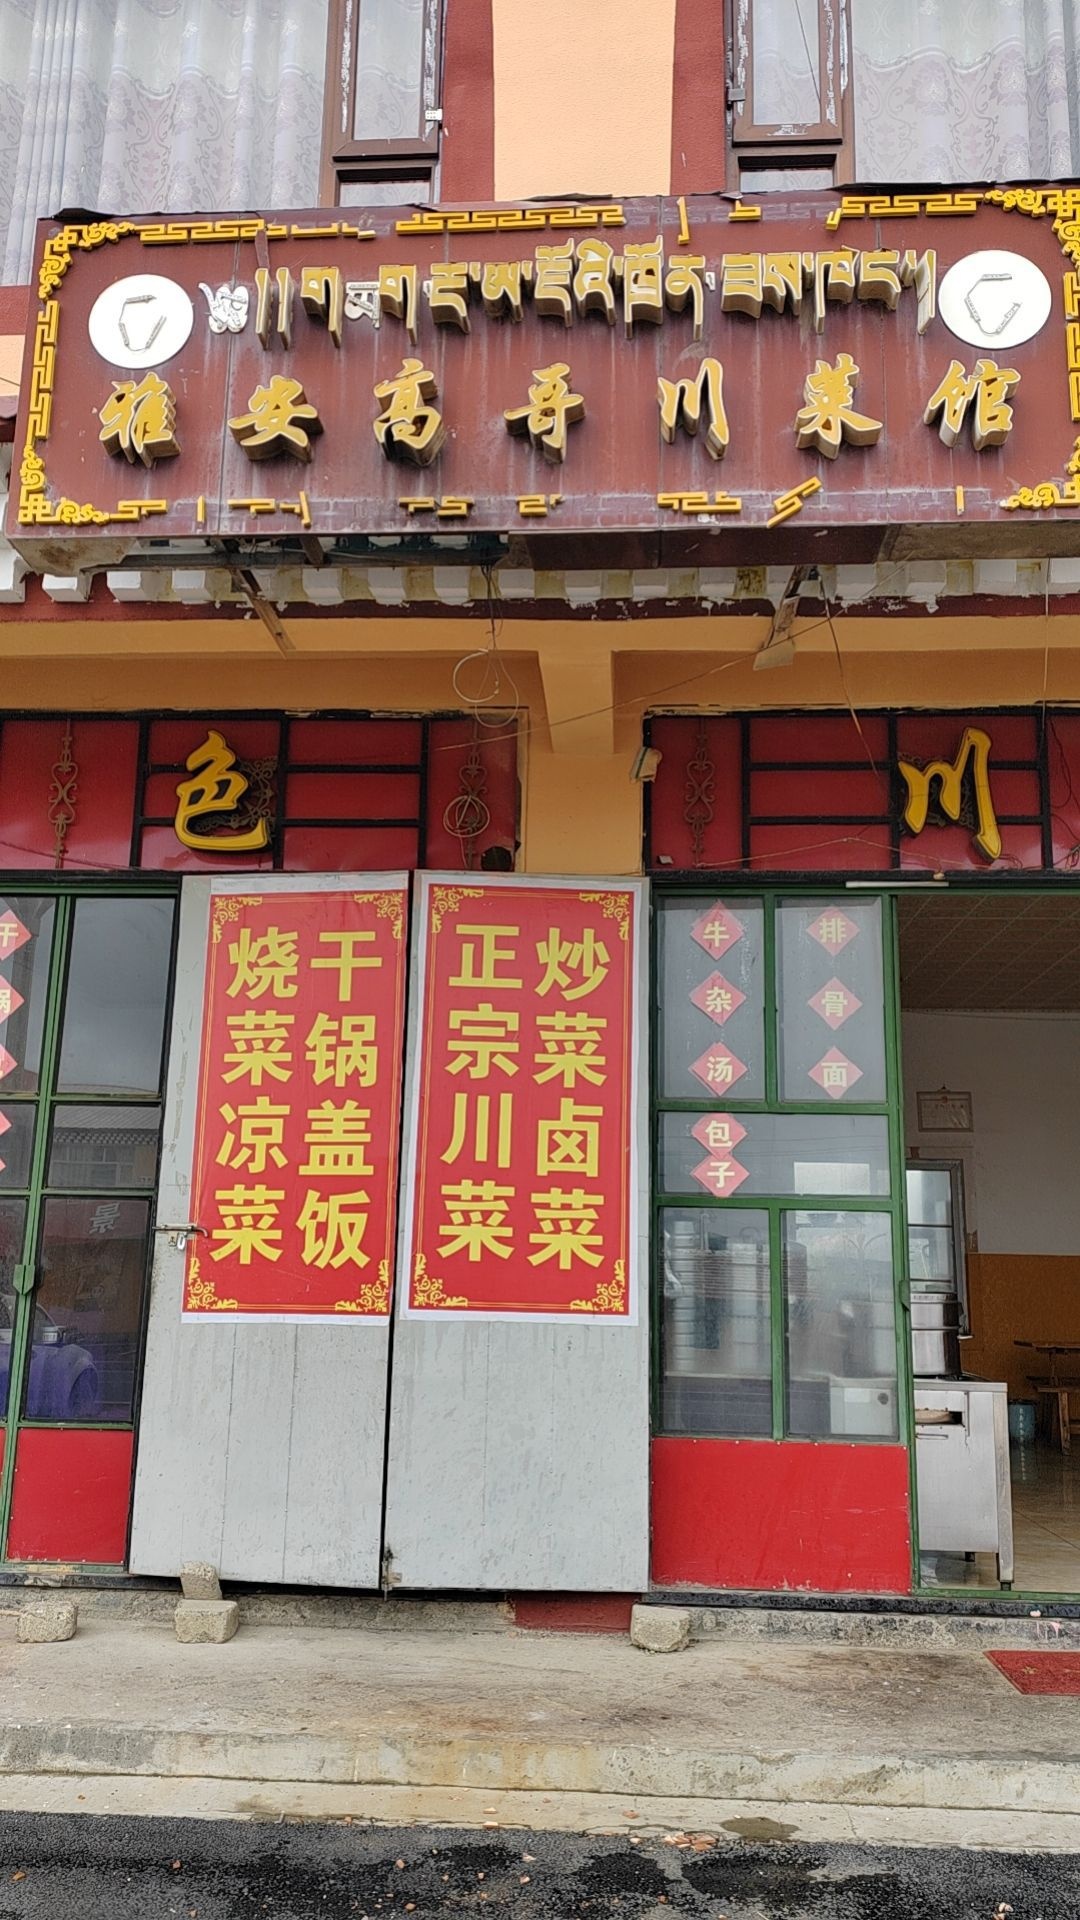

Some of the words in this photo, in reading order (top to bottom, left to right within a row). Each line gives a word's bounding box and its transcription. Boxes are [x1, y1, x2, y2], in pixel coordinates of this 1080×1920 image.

[98, 353, 1022, 469] 雅安高哥川菜馆
[173, 730, 269, 852] 色
[897, 727, 1002, 860] 川
[210, 926, 300, 1265] 烧菜凉菜
[296, 930, 383, 1270] 干锅盖饭
[437, 924, 523, 1262] 正宗川菜
[527, 927, 611, 1270] 炒菜卤菜
[818, 917, 848, 1089] 排骨面
